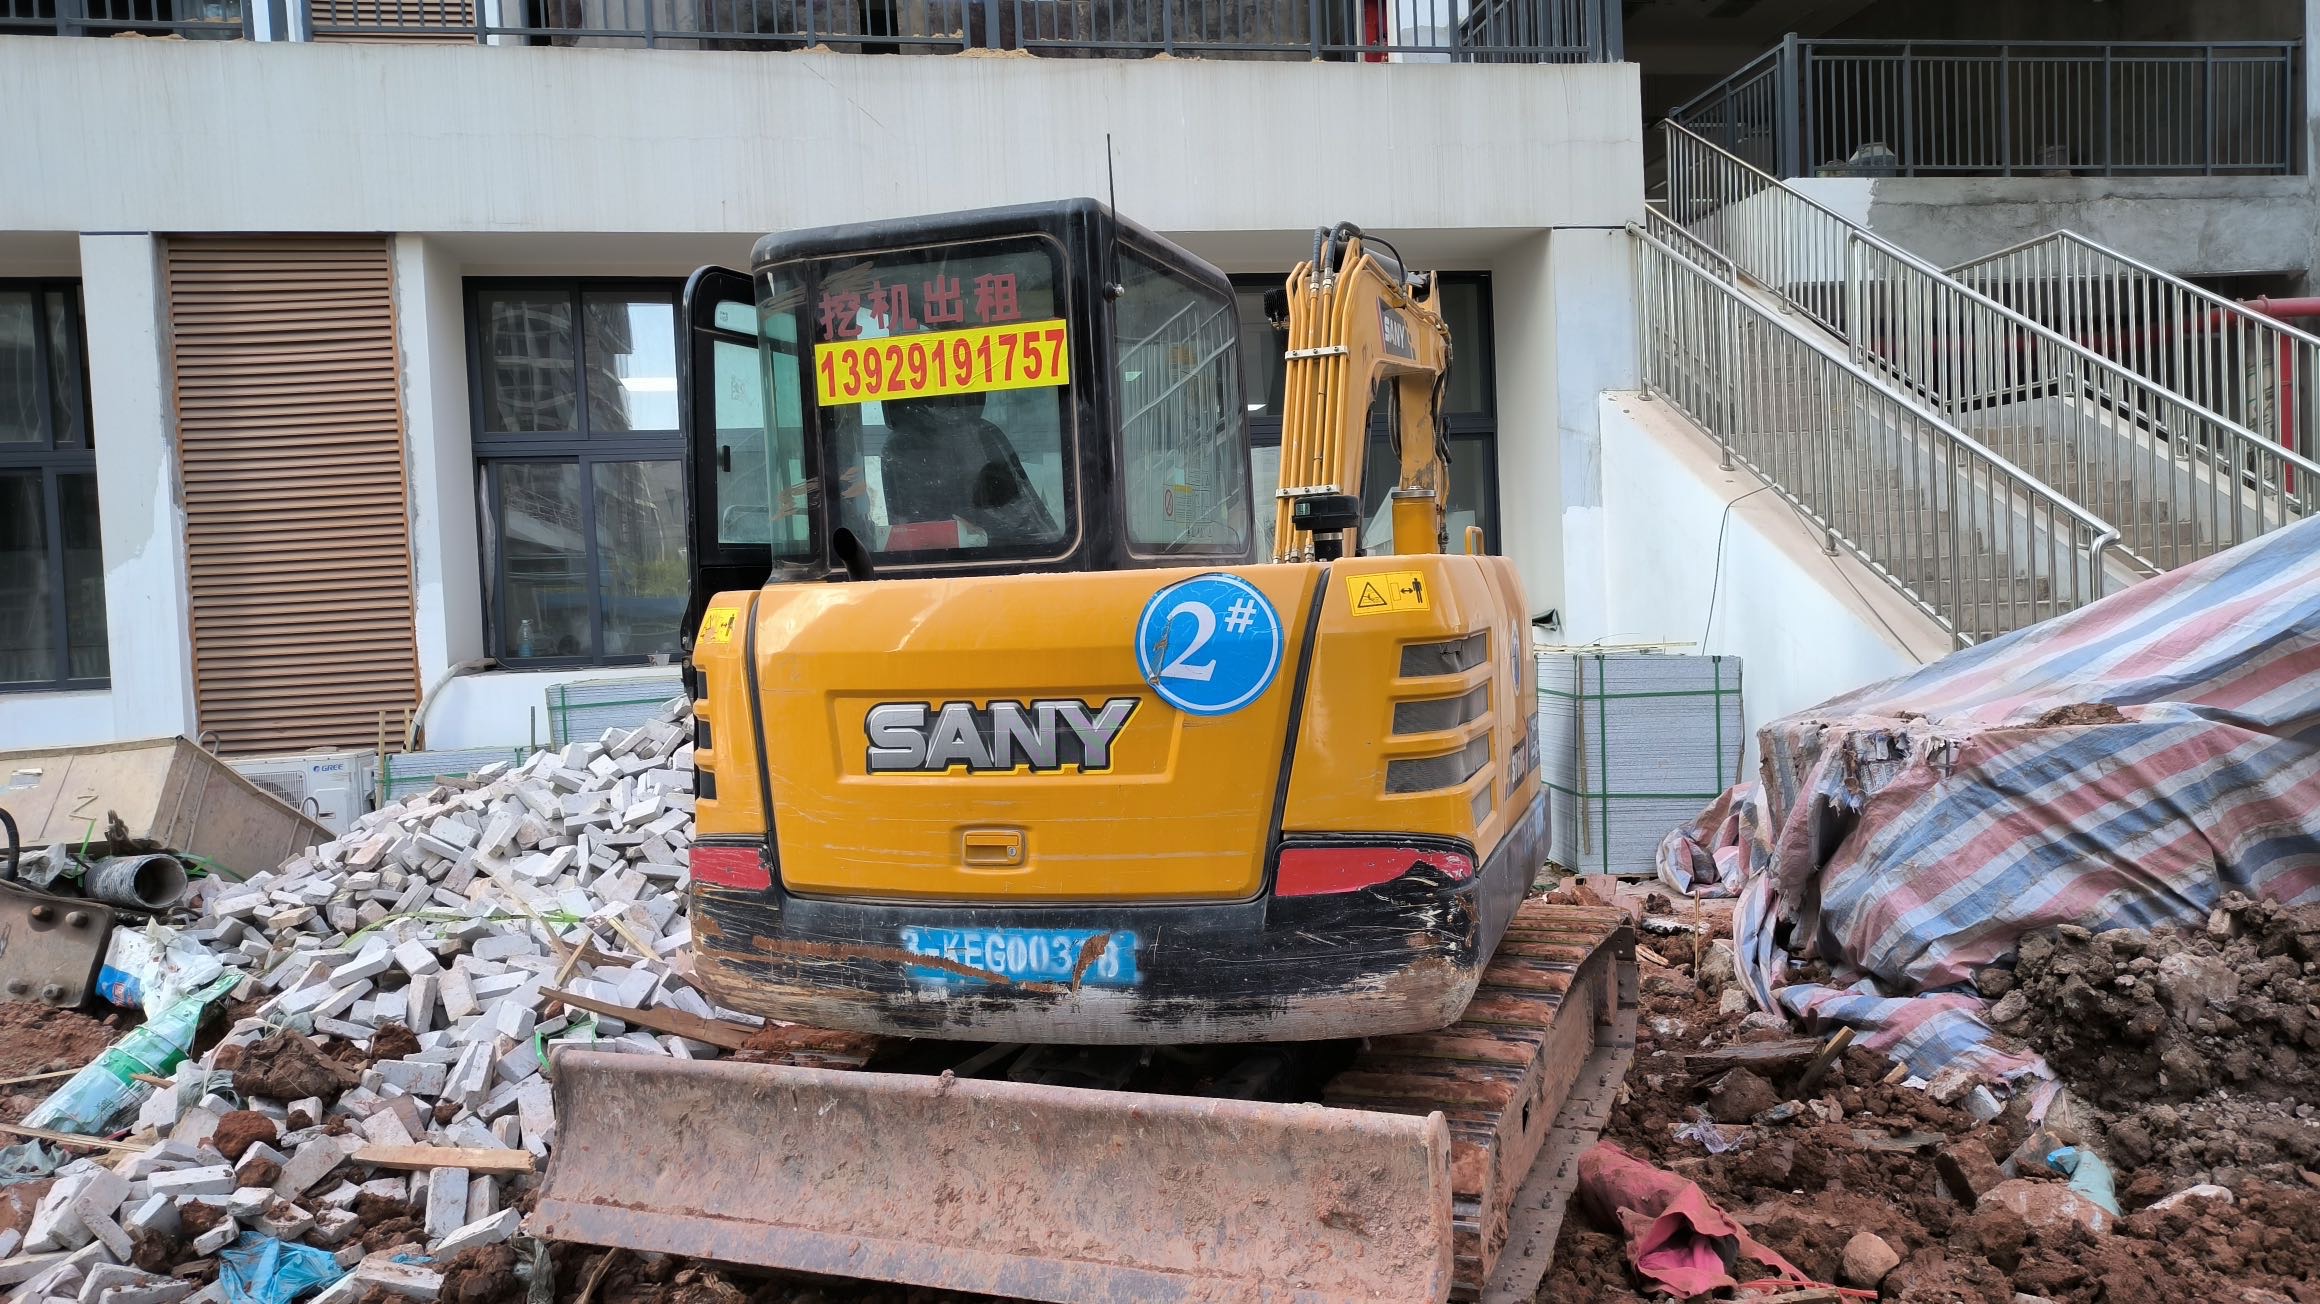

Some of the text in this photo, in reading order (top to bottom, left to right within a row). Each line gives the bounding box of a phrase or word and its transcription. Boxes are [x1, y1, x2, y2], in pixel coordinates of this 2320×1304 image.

[818, 272, 1022, 341] 挖机出租
[1384, 315, 1405, 349] SANY
[820, 328, 1066, 398] 13929191757
[1159, 598, 1257, 681] 2#
[321, 763, 344, 771] GREE
[865, 698, 1142, 772] SANY
